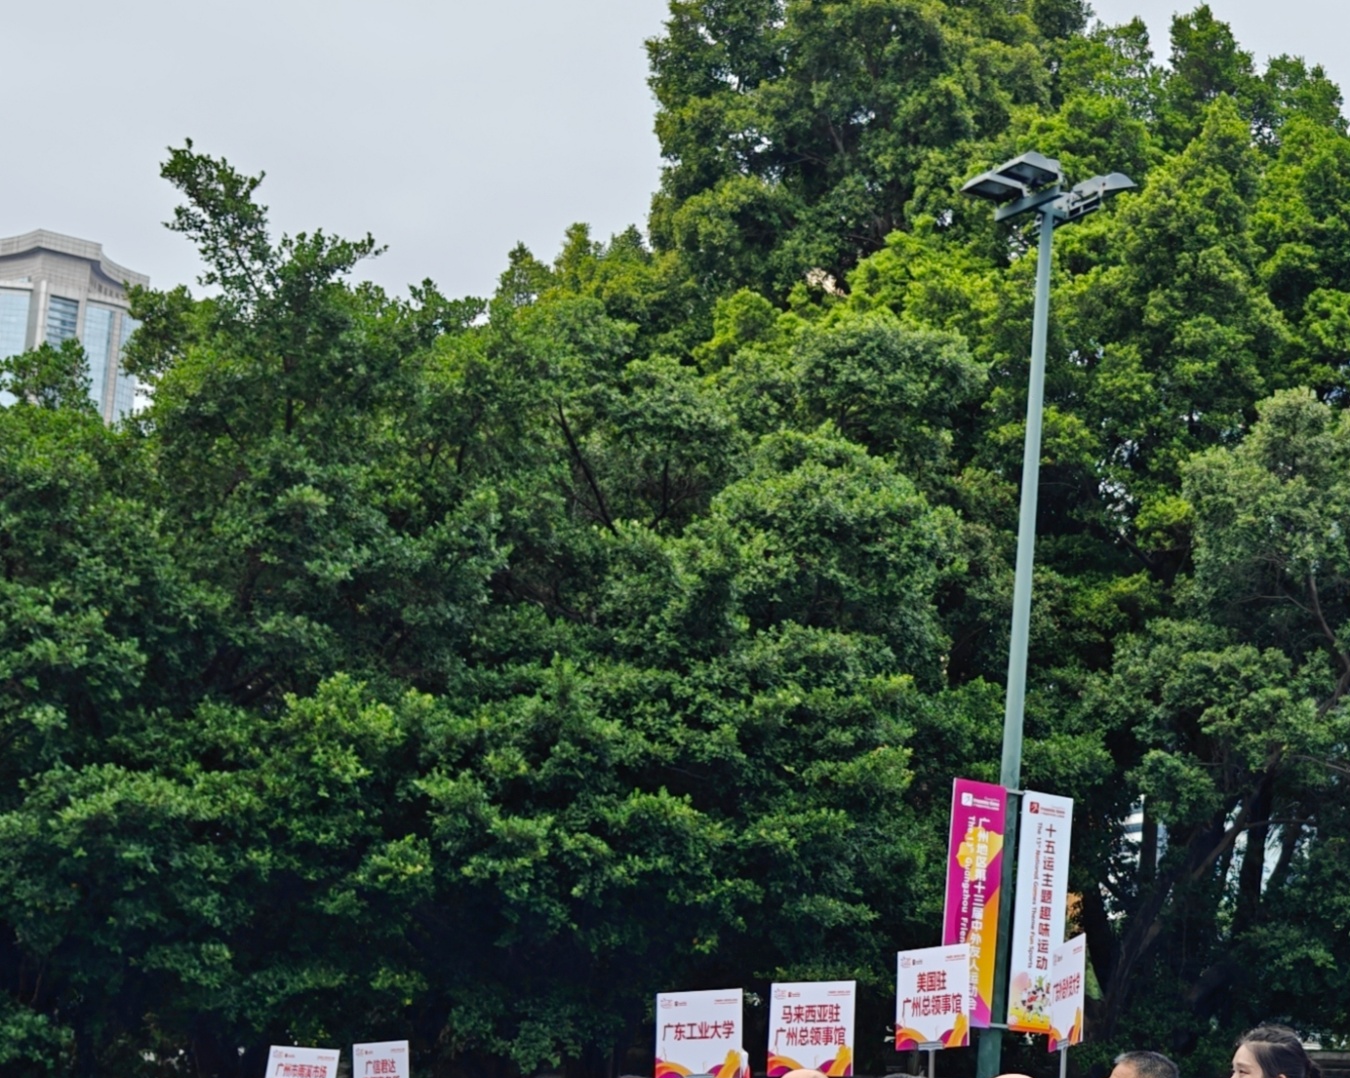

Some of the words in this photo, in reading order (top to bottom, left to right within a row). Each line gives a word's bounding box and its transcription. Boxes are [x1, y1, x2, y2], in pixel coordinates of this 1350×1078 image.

[961, 857, 972, 913] Guangzhou
[1036, 823, 1057, 970] 十五运主题趣味运动
[1027, 947, 1035, 968] Sports
[917, 970, 947, 993] 美国驻
[782, 1003, 841, 1024] 马来西亚驻
[902, 994, 962, 1017] 广州总领事馆
[662, 1020, 735, 1041] 广东工业大学
[774, 1026, 846, 1046] 广州总领事馆
[365, 1059, 396, 1075] 广信君达
